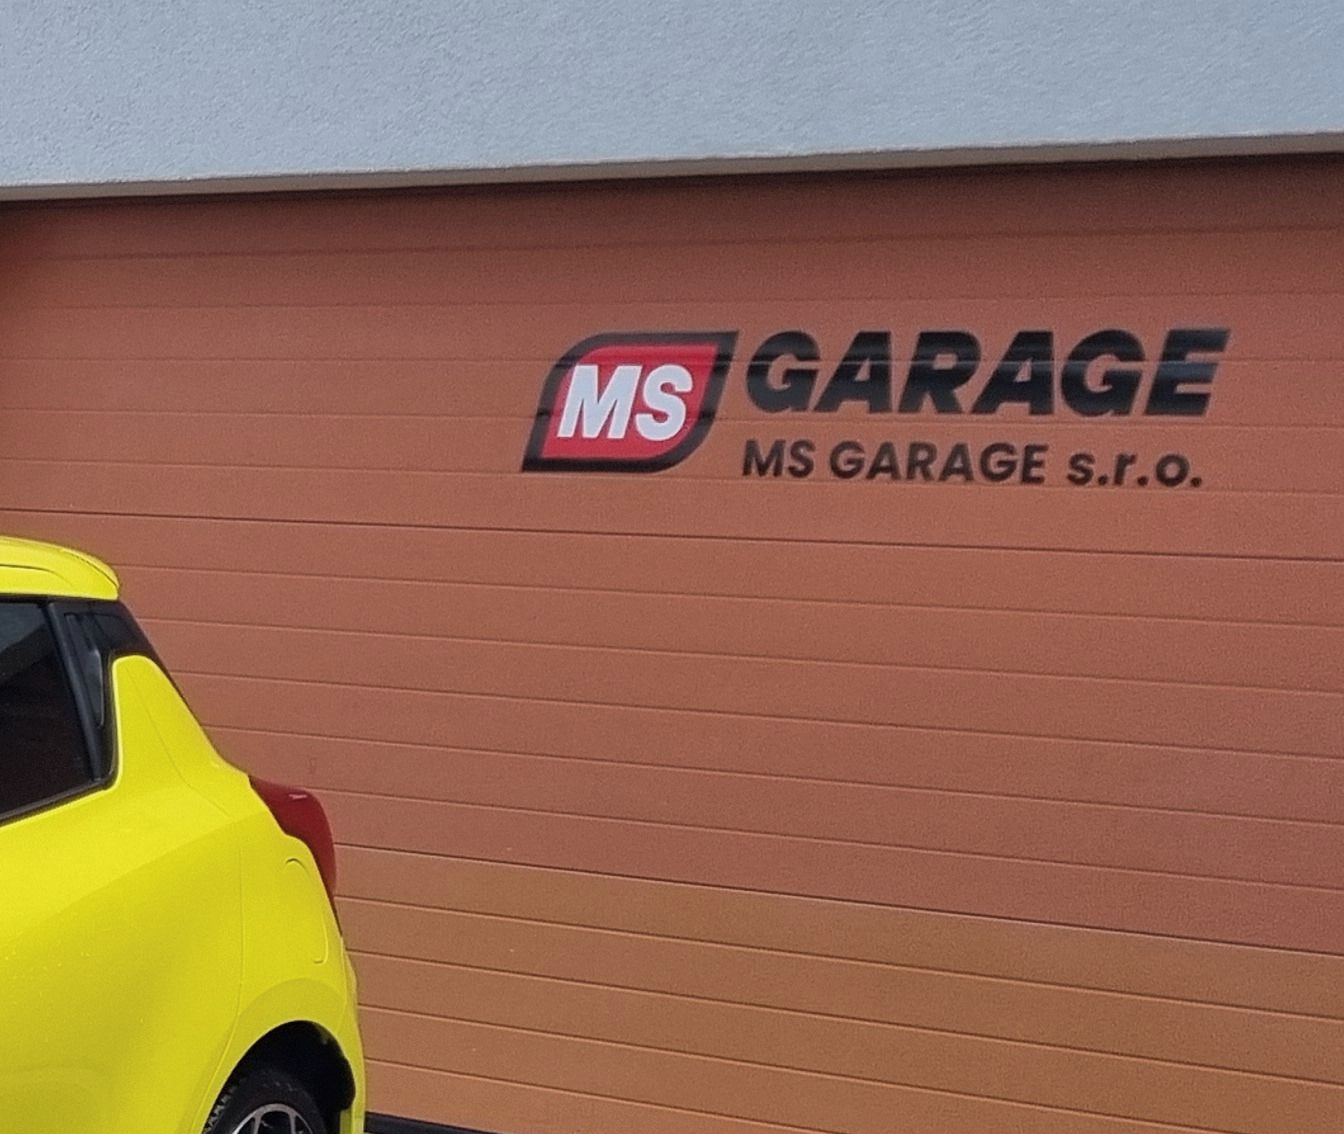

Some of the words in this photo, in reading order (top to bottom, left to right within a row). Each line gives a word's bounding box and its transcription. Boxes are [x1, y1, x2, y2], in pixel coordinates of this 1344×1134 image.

[557, 363, 693, 441] MS
[747, 329, 1230, 417] GARAGE
[743, 439, 815, 478] MS
[830, 441, 1049, 484] GARAGE
[1067, 453, 1202, 488] s.r.o.
